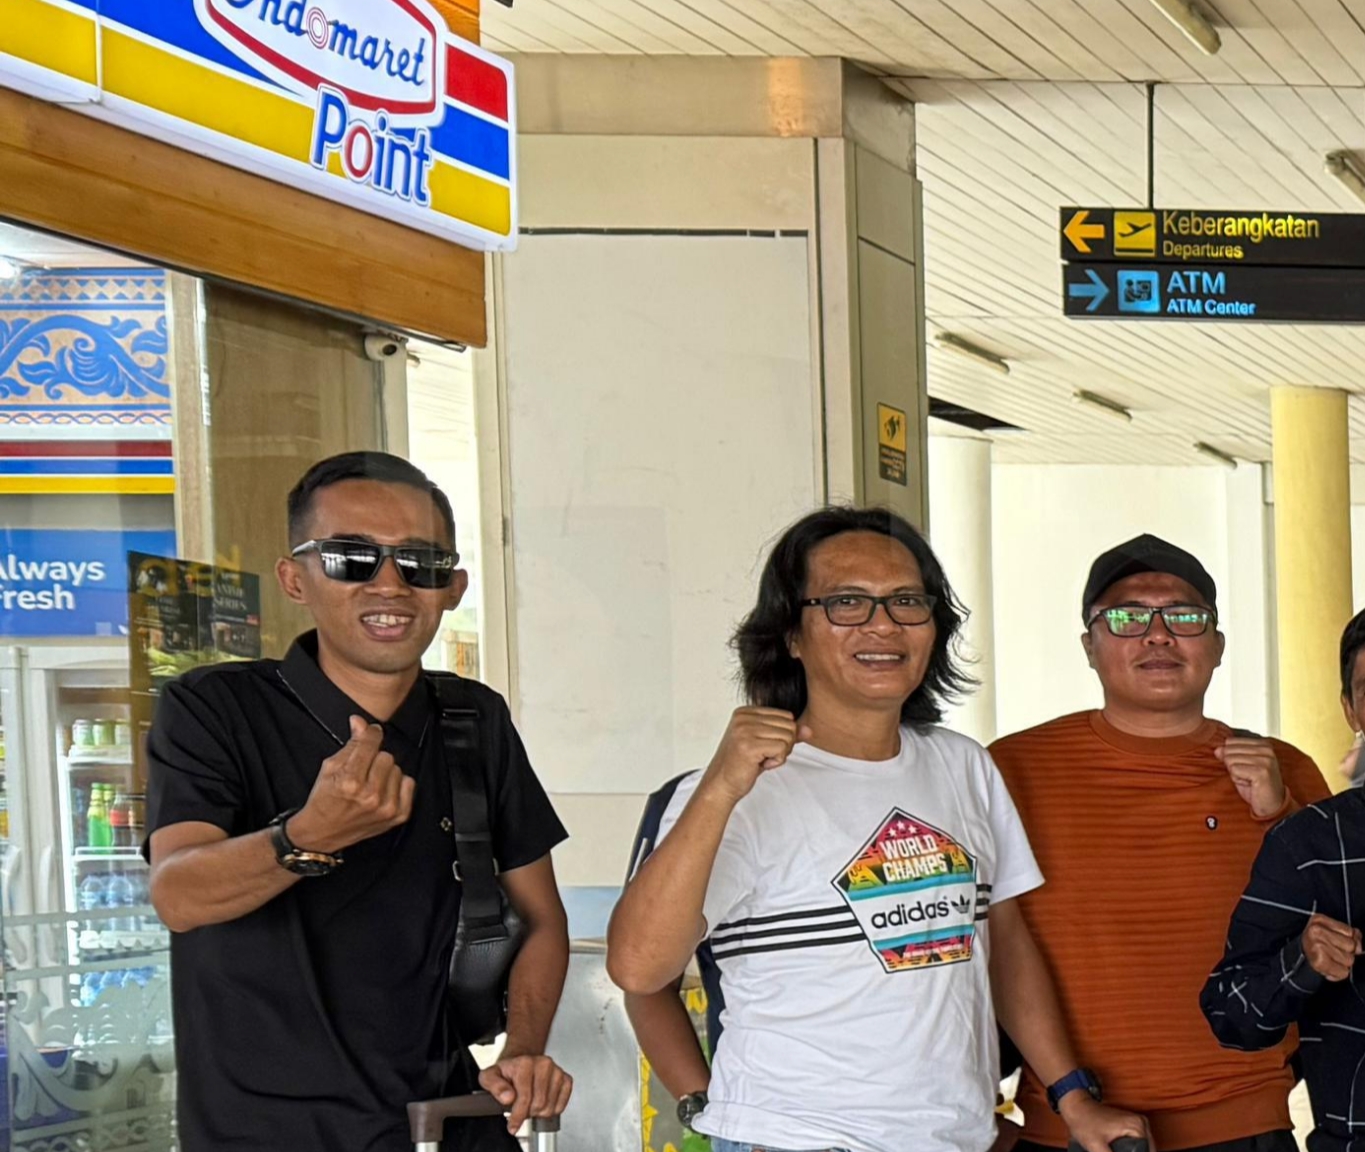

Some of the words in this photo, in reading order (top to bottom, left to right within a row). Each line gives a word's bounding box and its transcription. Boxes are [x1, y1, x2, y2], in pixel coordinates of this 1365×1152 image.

[223, 0, 426, 86] ndomaret
[312, 89, 430, 202] Point
[1162, 212, 1320, 243] Keberangkatan
[1162, 240, 1244, 260] Departures
[1167, 271, 1226, 294] ATM
[1167, 299, 1202, 314] ATM
[1204, 301, 1256, 316] Center
[880, 834, 938, 860] WORLD
[882, 852, 948, 882] CHAMPS
[870, 900, 950, 929] adidas
